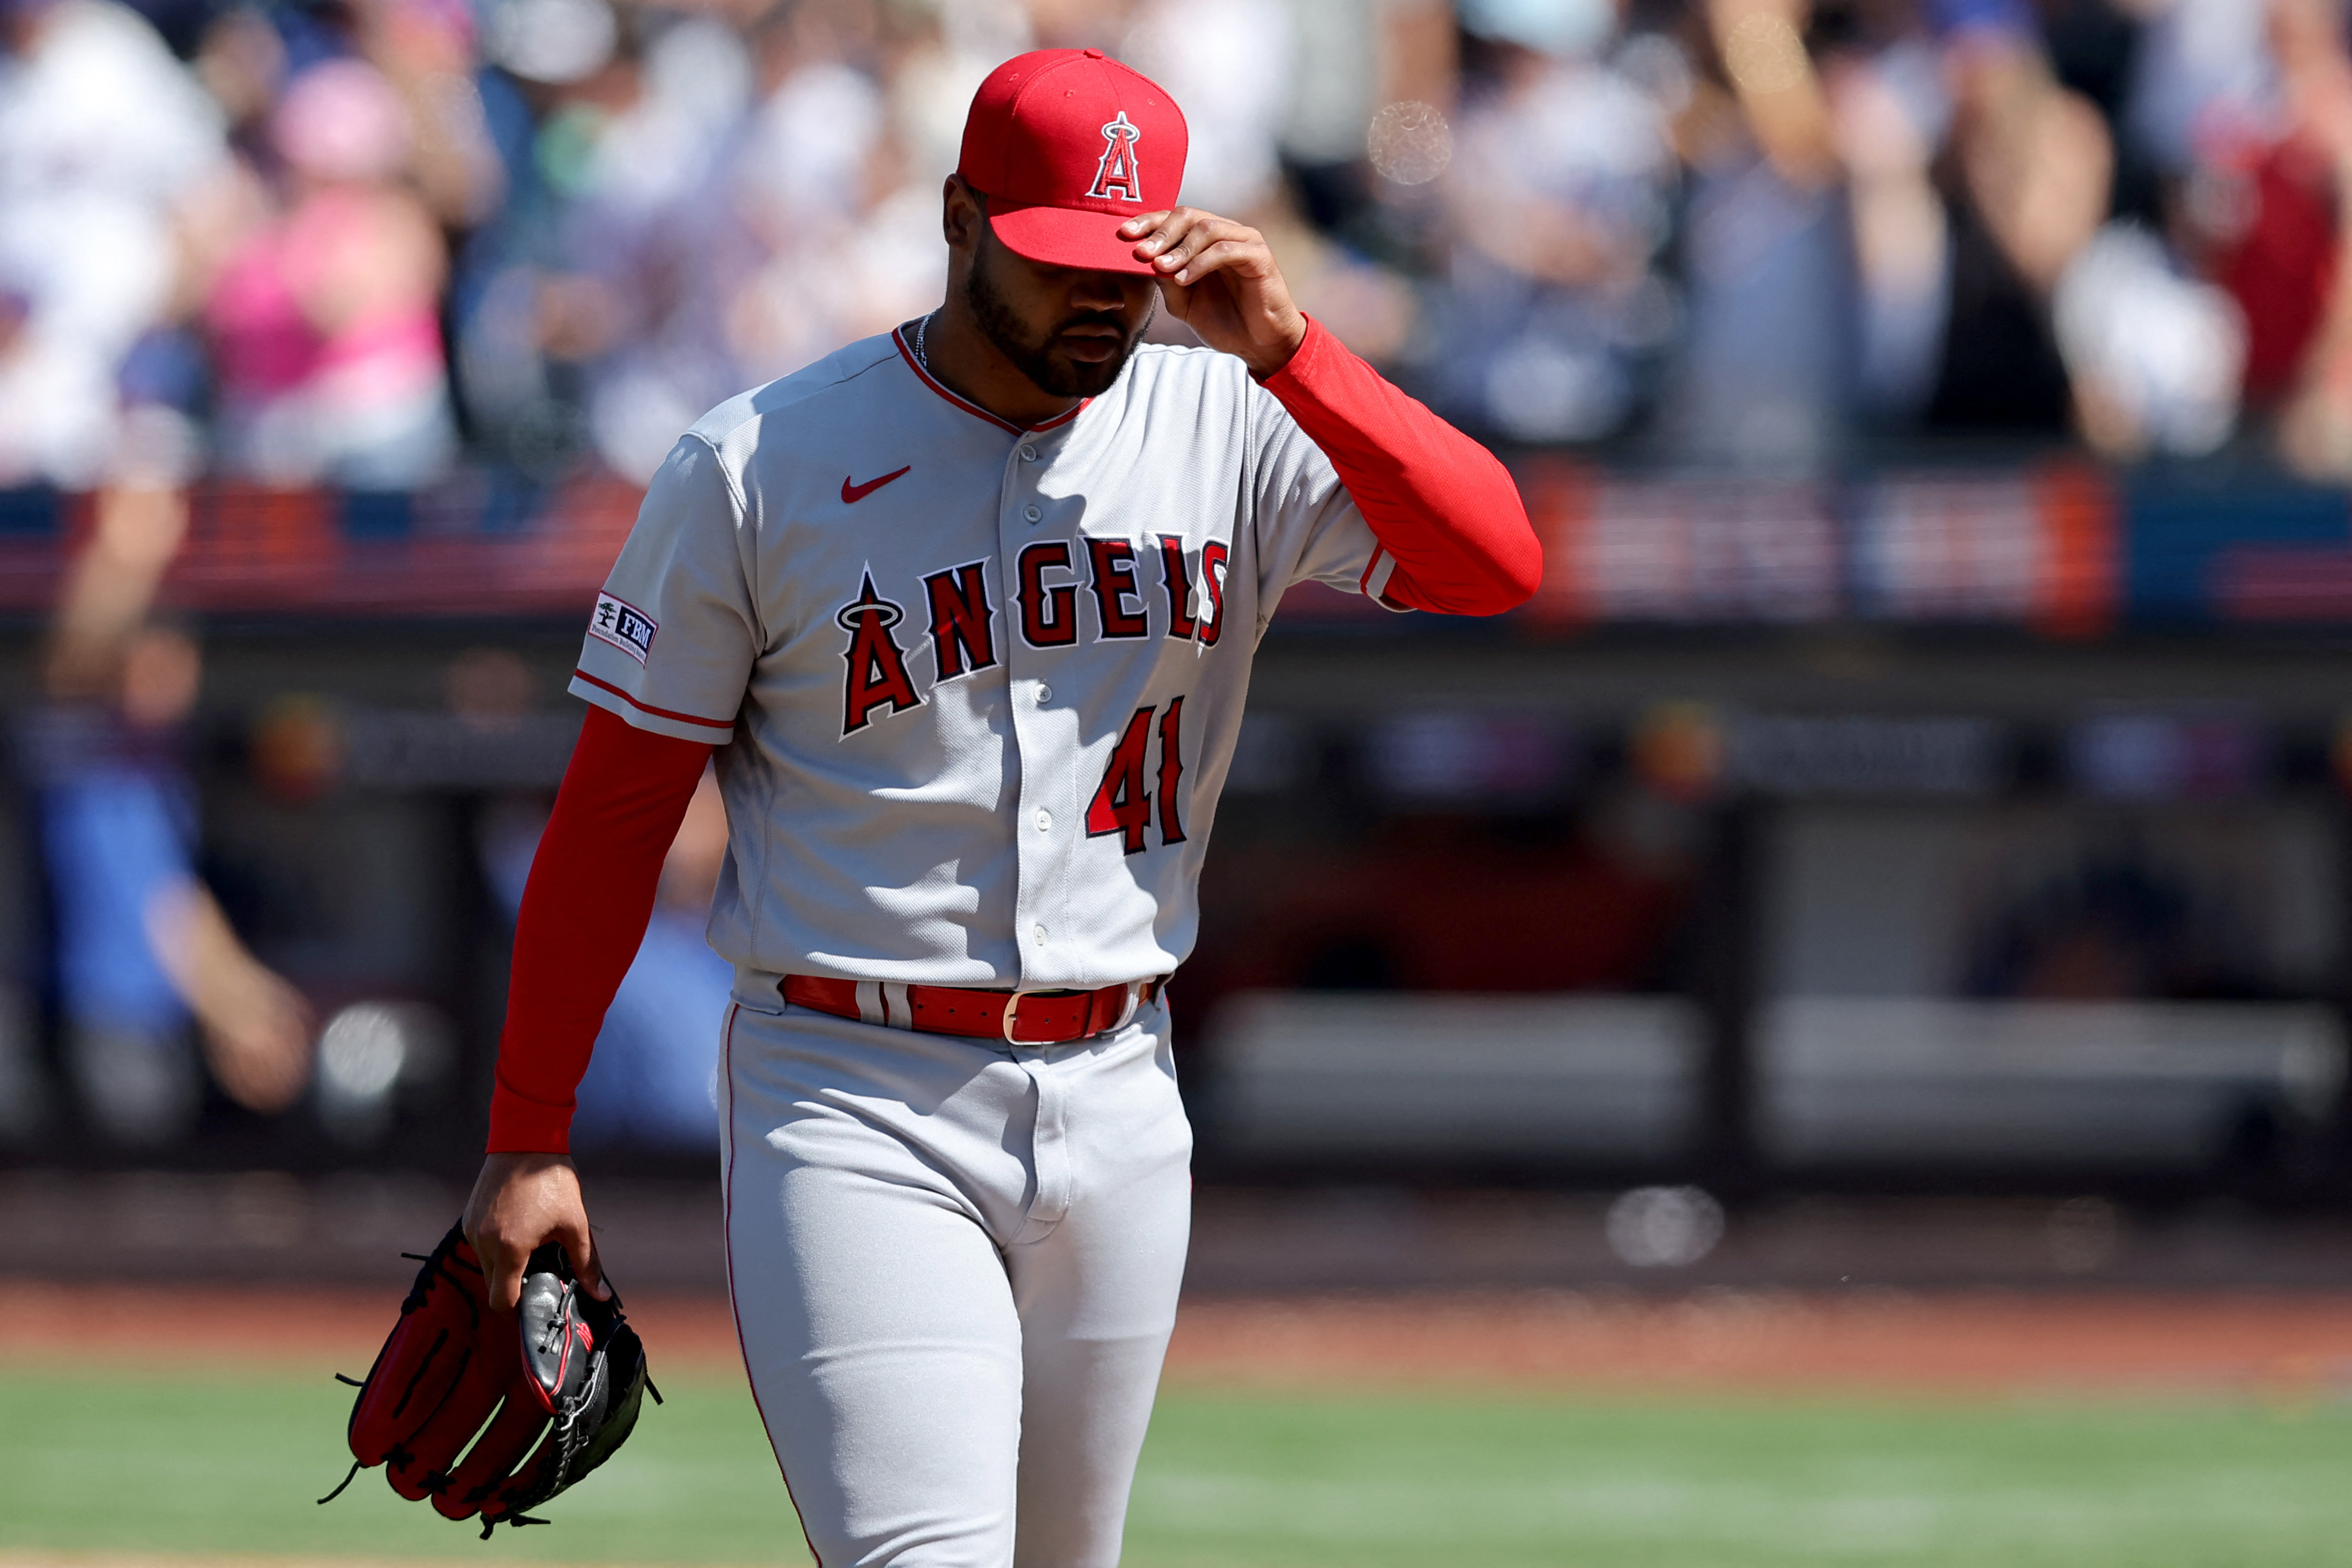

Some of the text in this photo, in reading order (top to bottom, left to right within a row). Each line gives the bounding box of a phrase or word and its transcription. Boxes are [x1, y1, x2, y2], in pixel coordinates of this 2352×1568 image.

[1085, 110, 1142, 203] A
[620, 613, 651, 649] FBM
[834, 532, 1230, 743] ANGELS
[1084, 694, 1187, 856] 41
